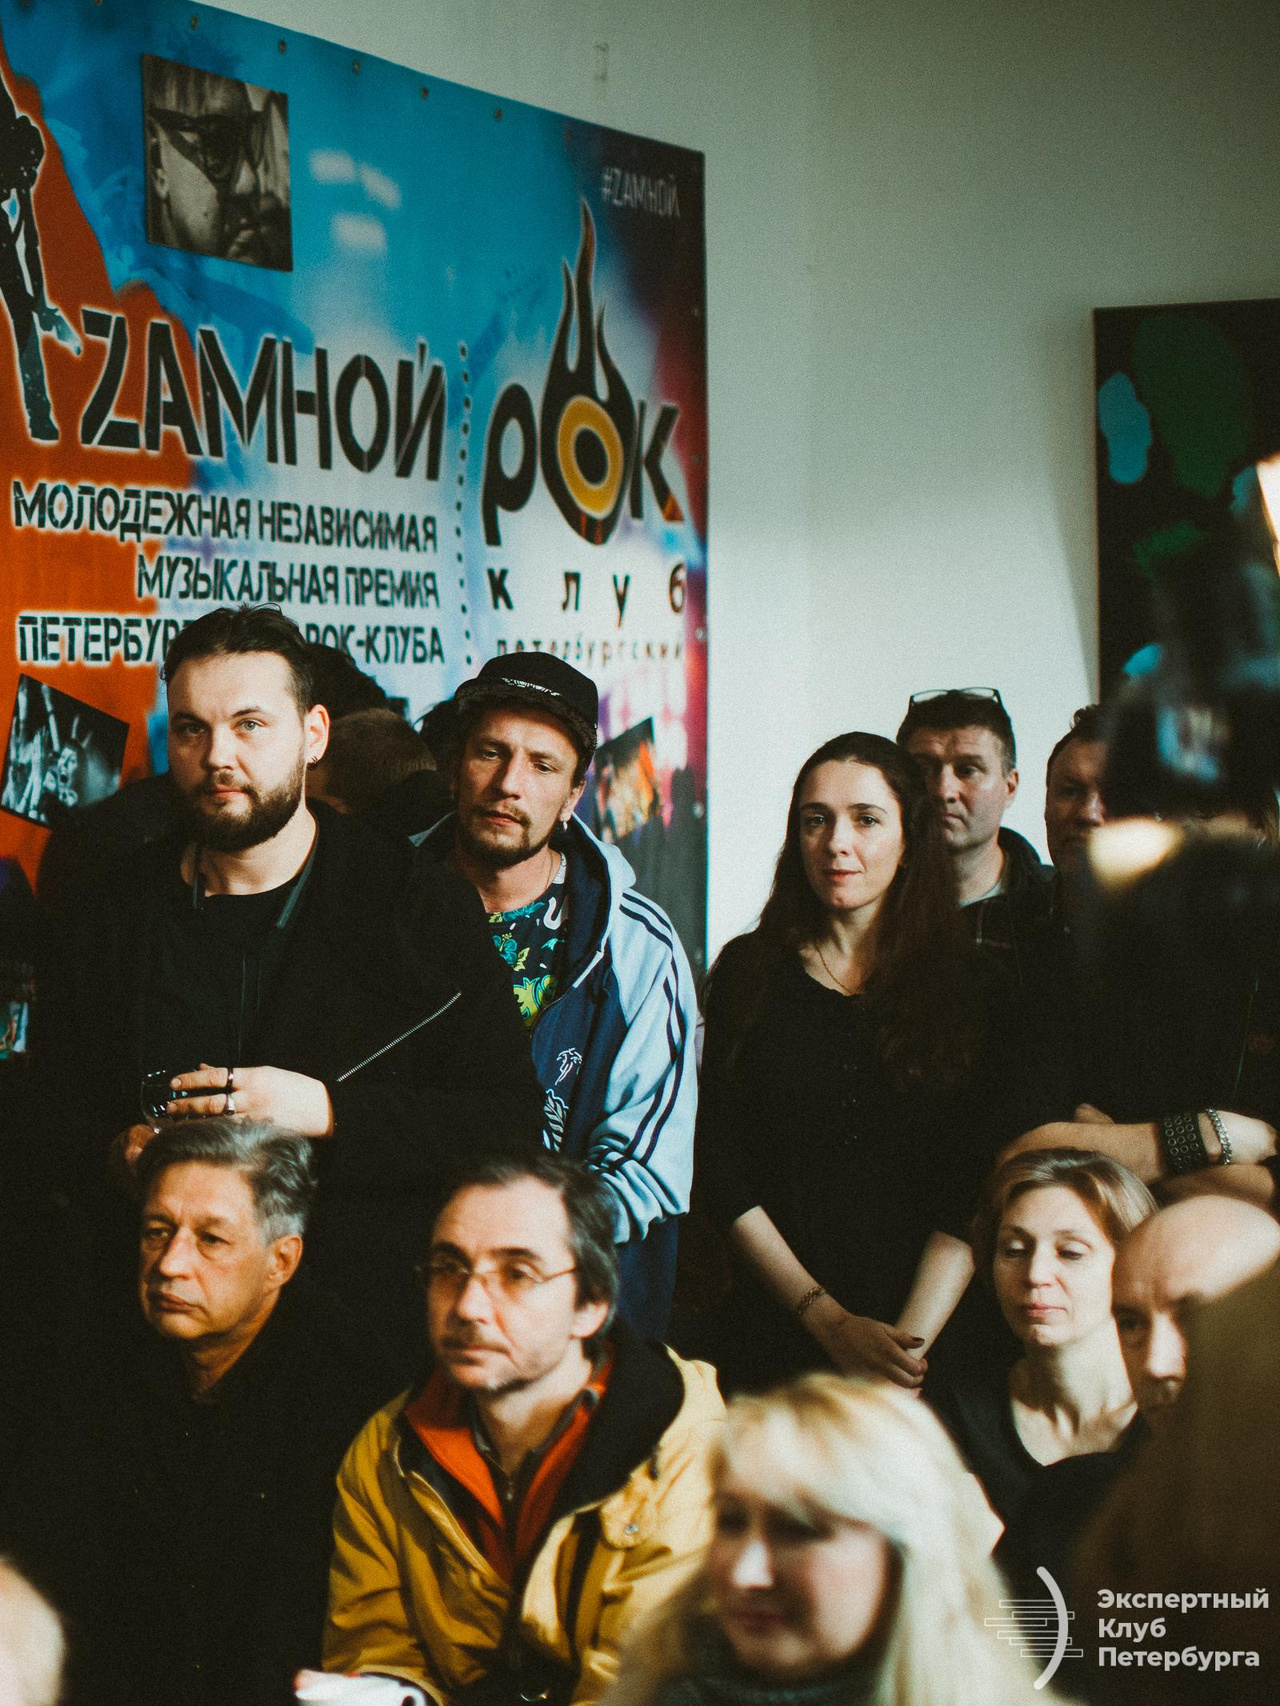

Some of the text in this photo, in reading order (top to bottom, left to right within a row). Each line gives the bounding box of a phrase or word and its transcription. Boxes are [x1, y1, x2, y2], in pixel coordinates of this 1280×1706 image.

[13, 480, 438, 553] МОЛОДЕЖНАЯ НЕЗАВИСИМАЯ
[137, 554, 440, 608] МУЗЫКАЛЬНАЯ ПРЕМИЯ
